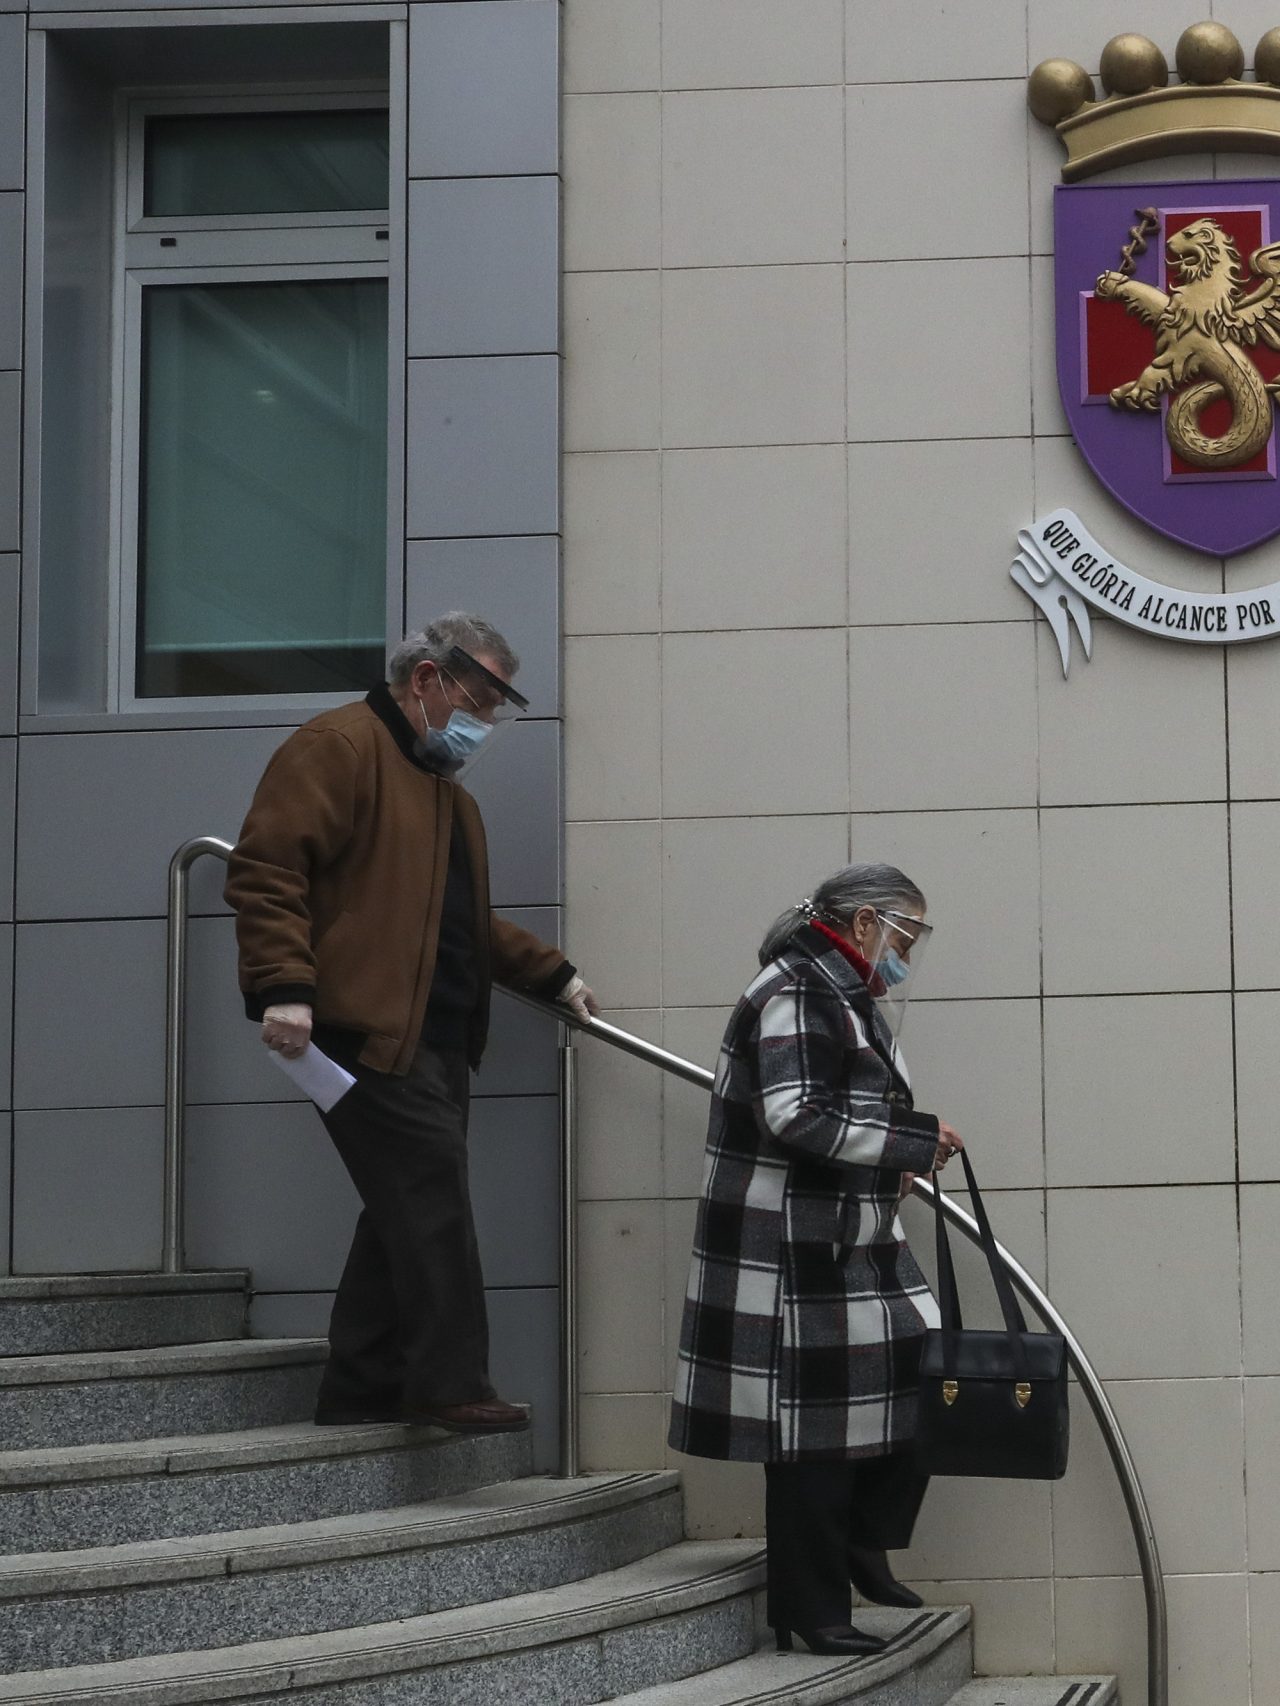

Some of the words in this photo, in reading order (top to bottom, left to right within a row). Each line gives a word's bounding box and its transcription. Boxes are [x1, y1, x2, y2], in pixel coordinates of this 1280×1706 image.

[1043, 520, 1080, 559] QUE
[1071, 552, 1137, 611] GLÓRIA
[1138, 594, 1227, 632] ALCANCE
[1237, 603, 1275, 630] POR
